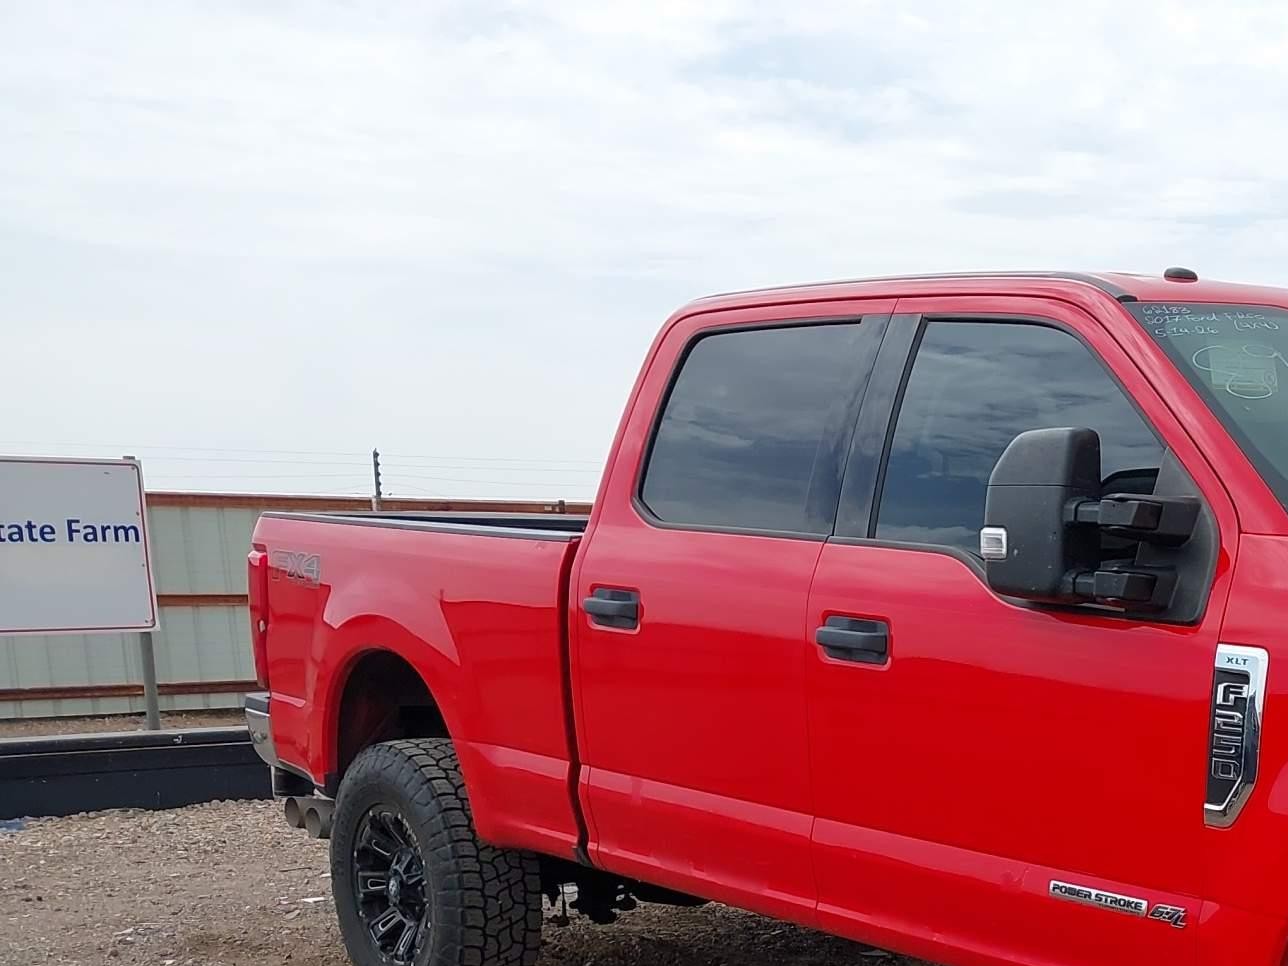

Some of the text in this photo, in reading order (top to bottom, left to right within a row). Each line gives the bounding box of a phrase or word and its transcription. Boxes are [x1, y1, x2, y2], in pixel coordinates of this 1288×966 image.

[66, 518, 140, 543] Farm
[271, 549, 321, 588] FX4
[1225, 656, 1249, 666] XLT
[1051, 882, 1144, 912] POWER STROKE
